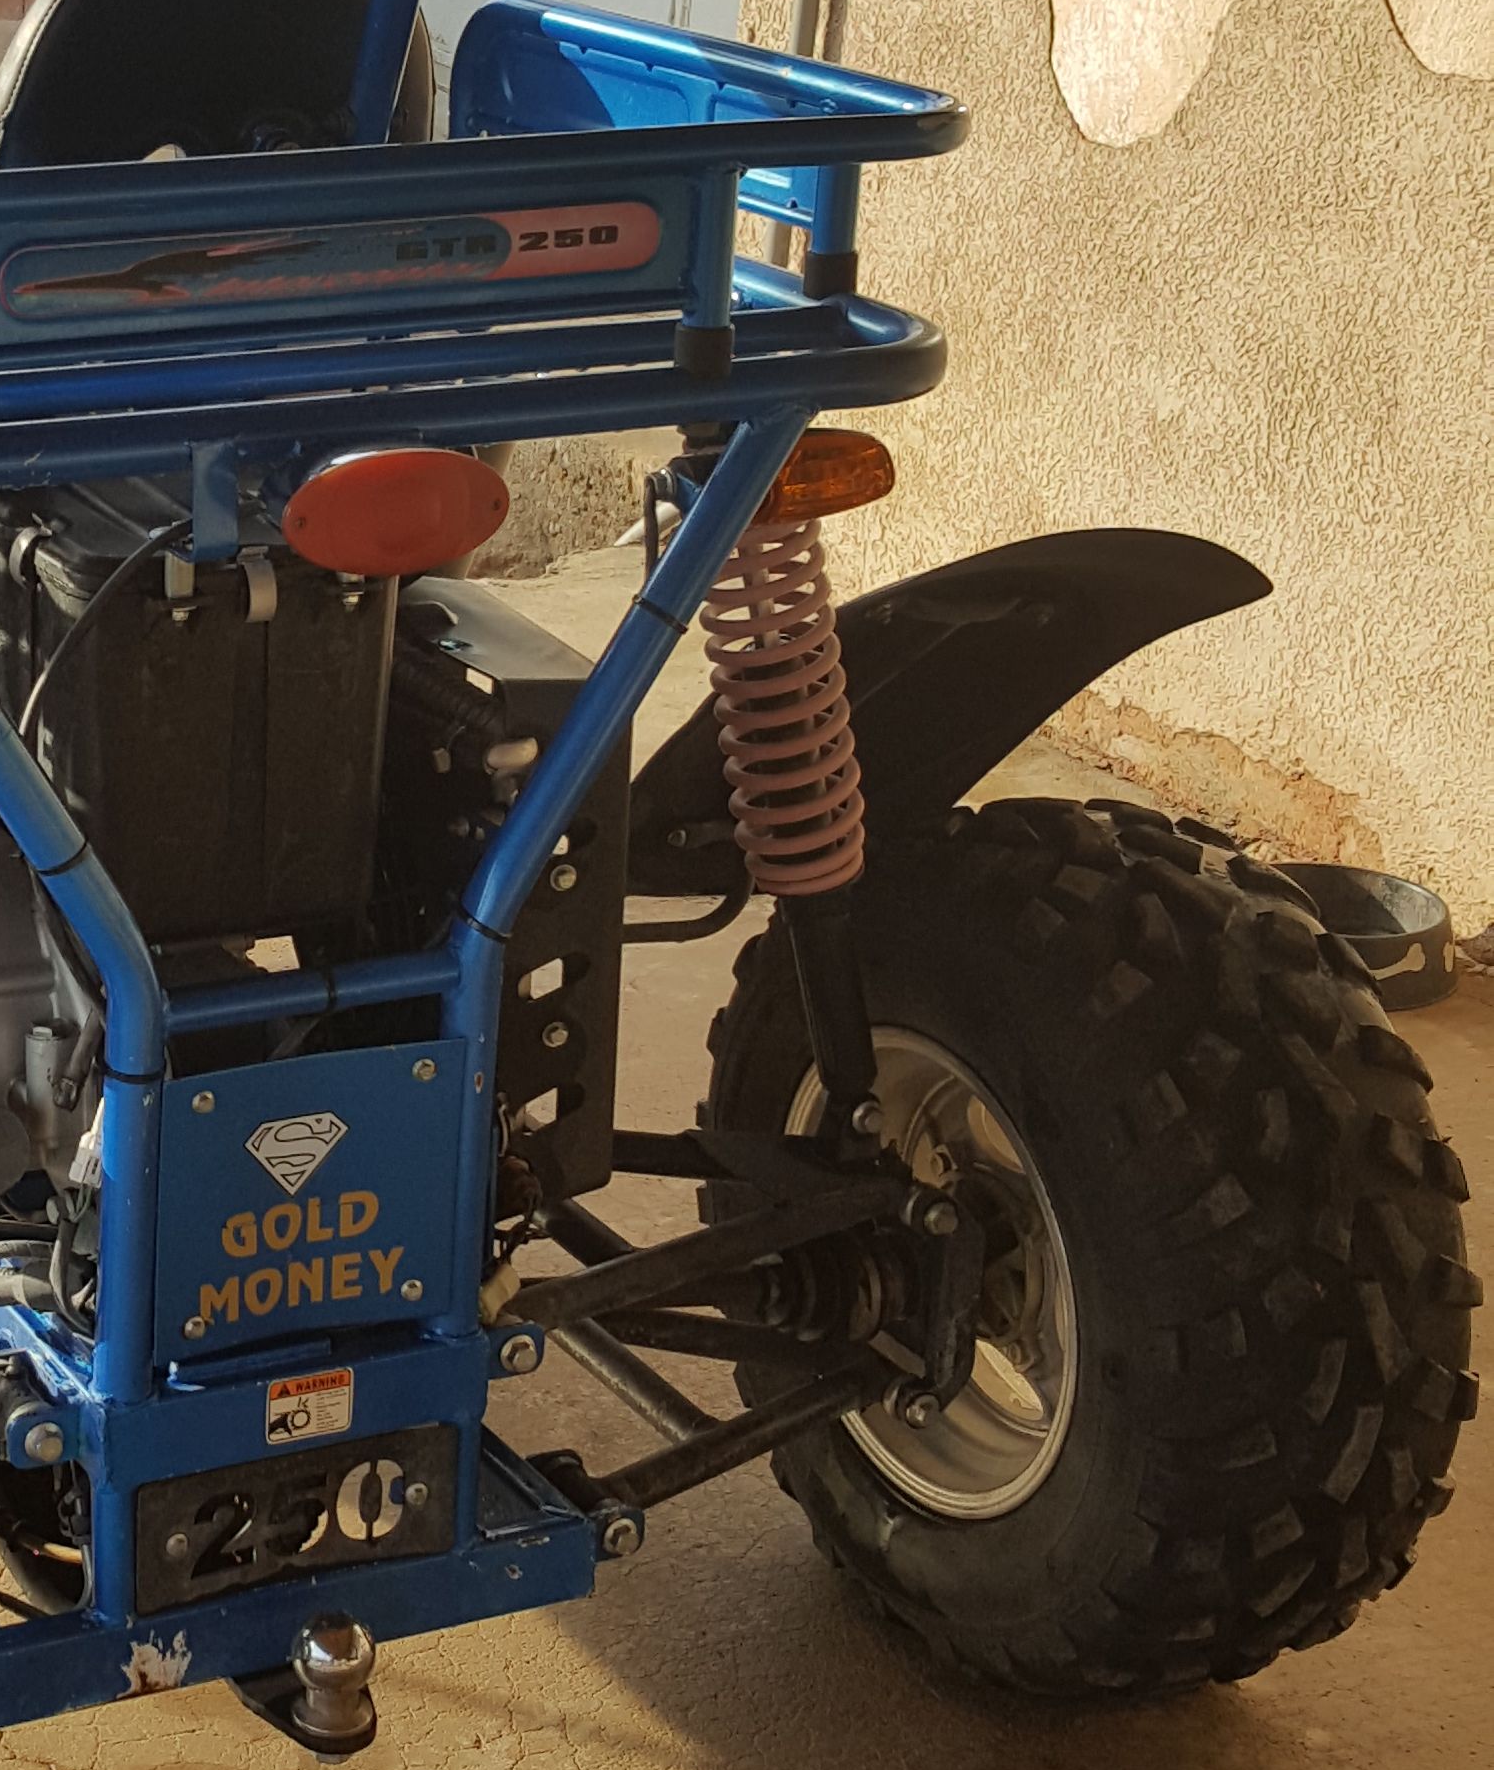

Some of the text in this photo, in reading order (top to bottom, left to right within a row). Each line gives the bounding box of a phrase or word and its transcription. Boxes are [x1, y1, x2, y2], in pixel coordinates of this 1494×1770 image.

[519, 225, 618, 252] 250
[222, 1190, 380, 1258] GOLD
[200, 1247, 404, 1325] MONEY
[295, 1374, 346, 1392] WARNING
[190, 1458, 404, 1580] 250
